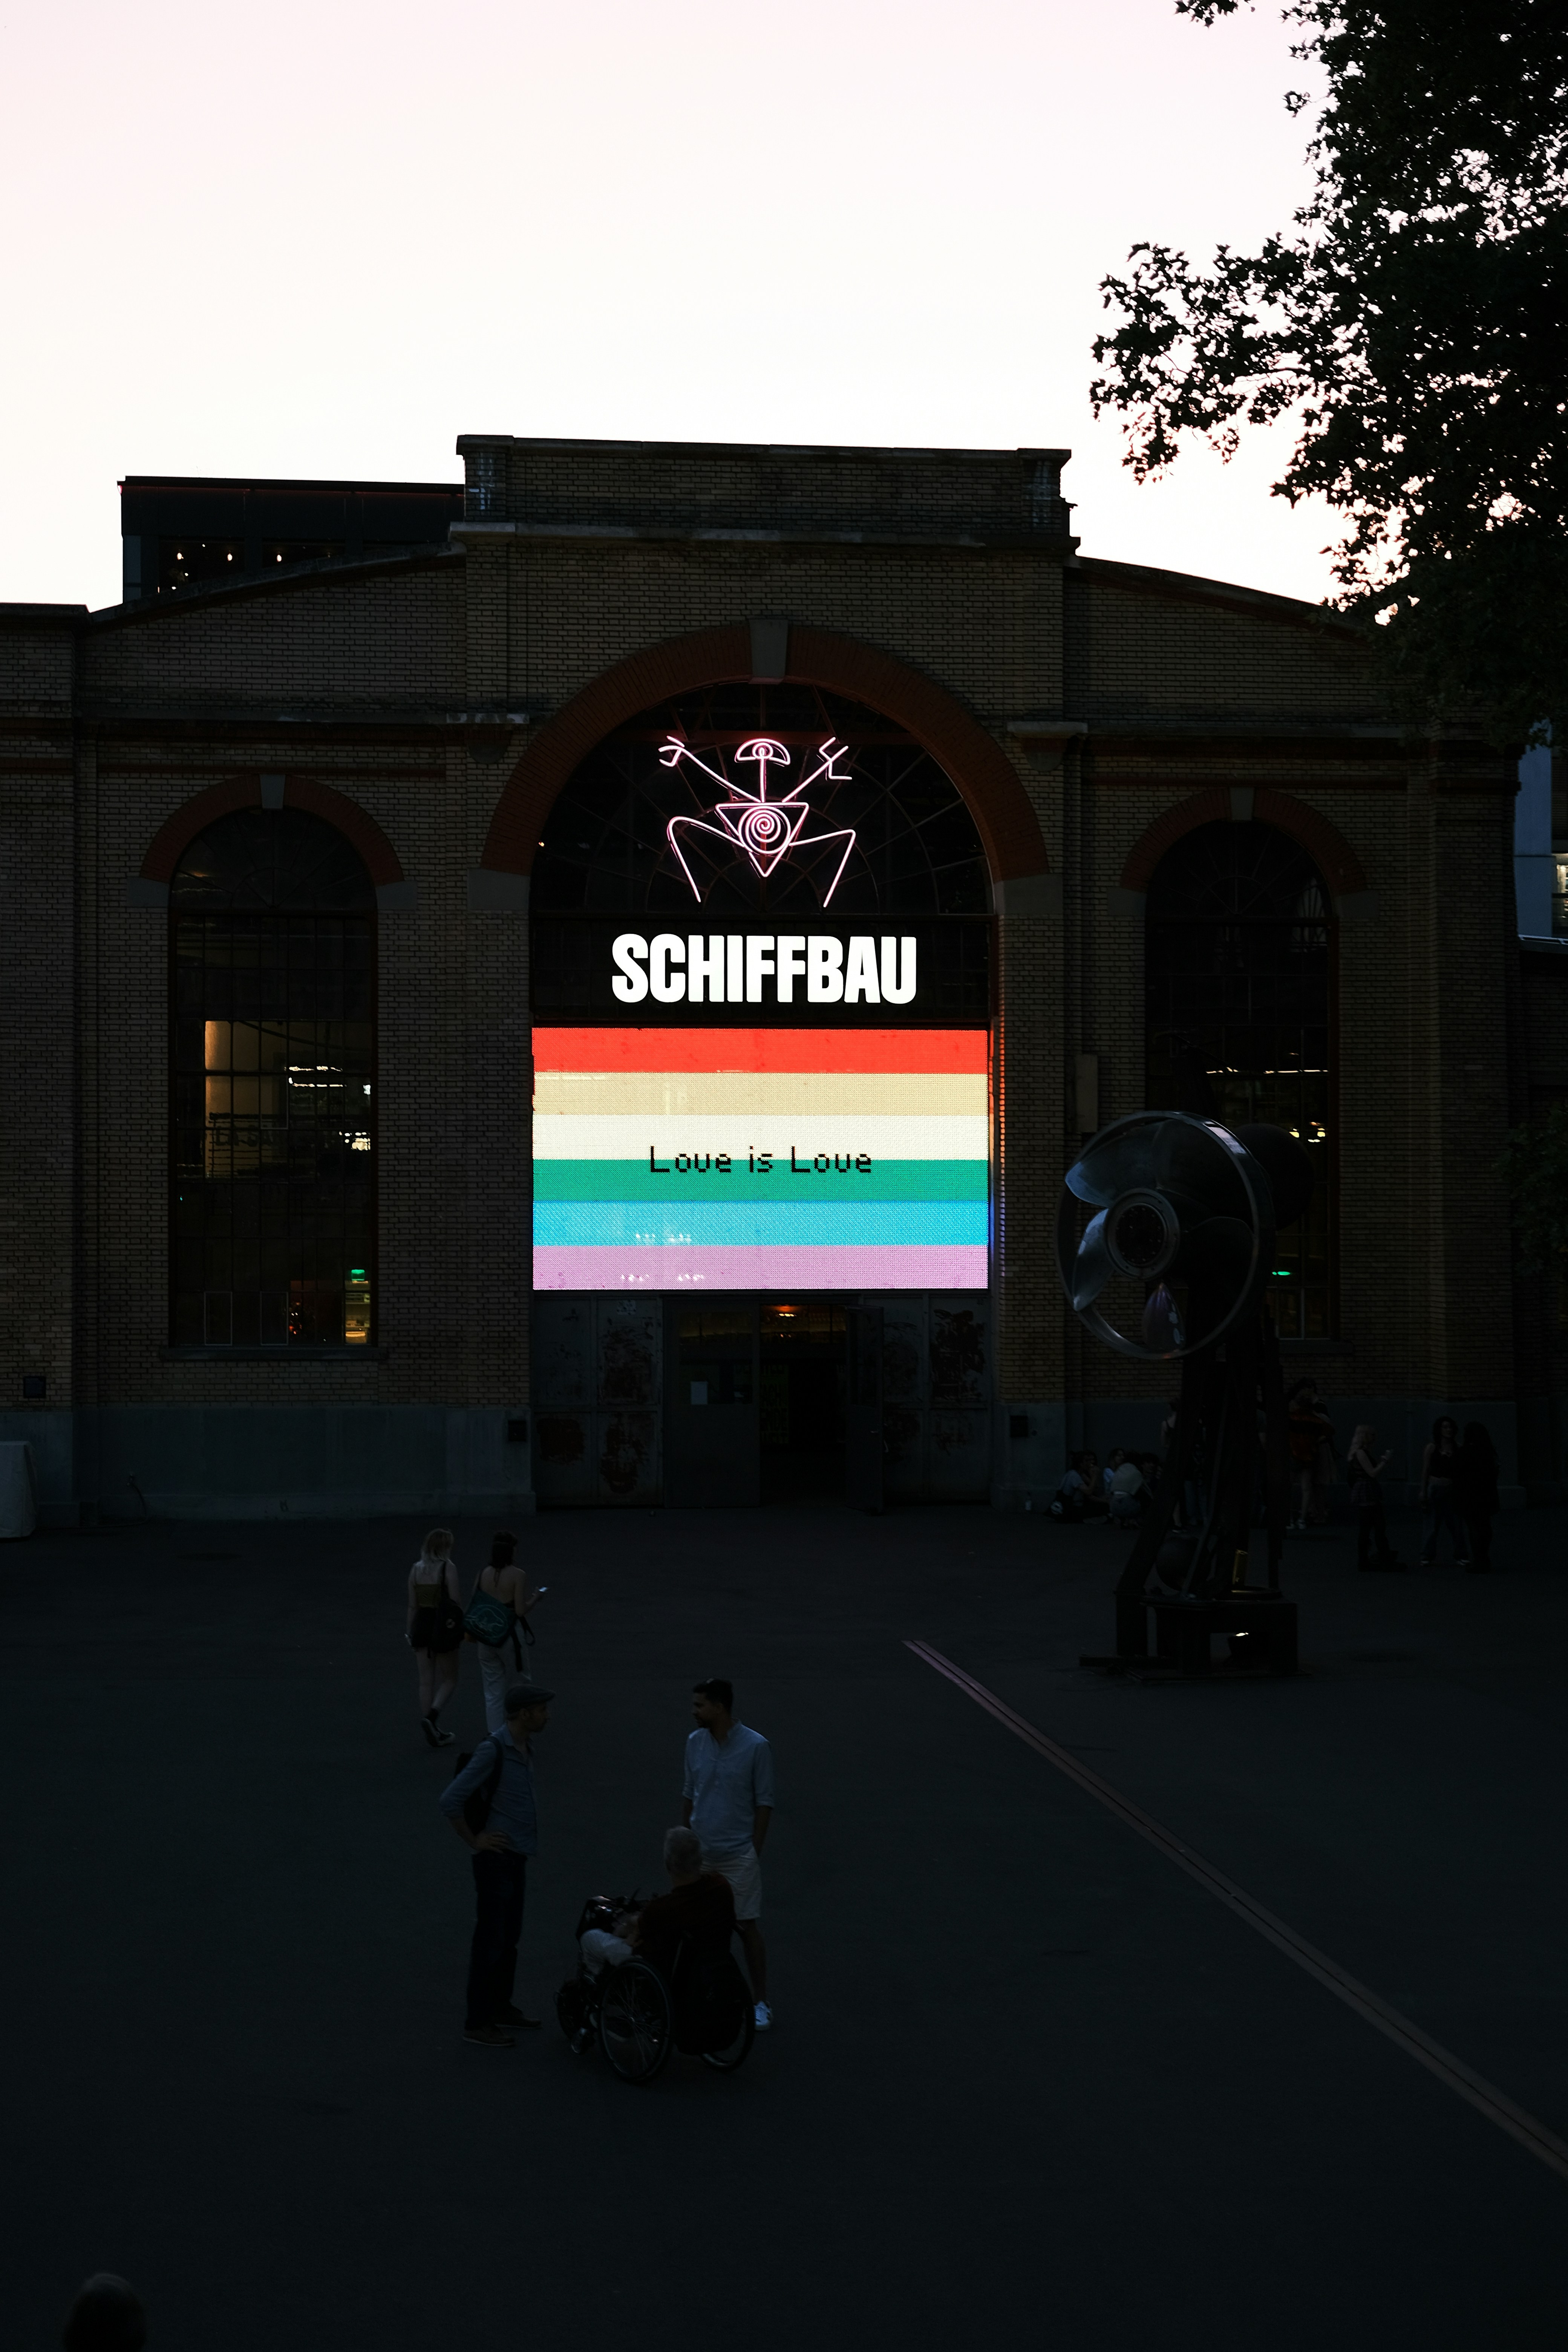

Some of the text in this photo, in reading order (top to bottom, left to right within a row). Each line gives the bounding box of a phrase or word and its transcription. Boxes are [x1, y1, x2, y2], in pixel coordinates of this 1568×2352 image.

[612, 934, 917, 1004] SCHIFFBAU
[650, 1146, 871, 1173] Love is Love
